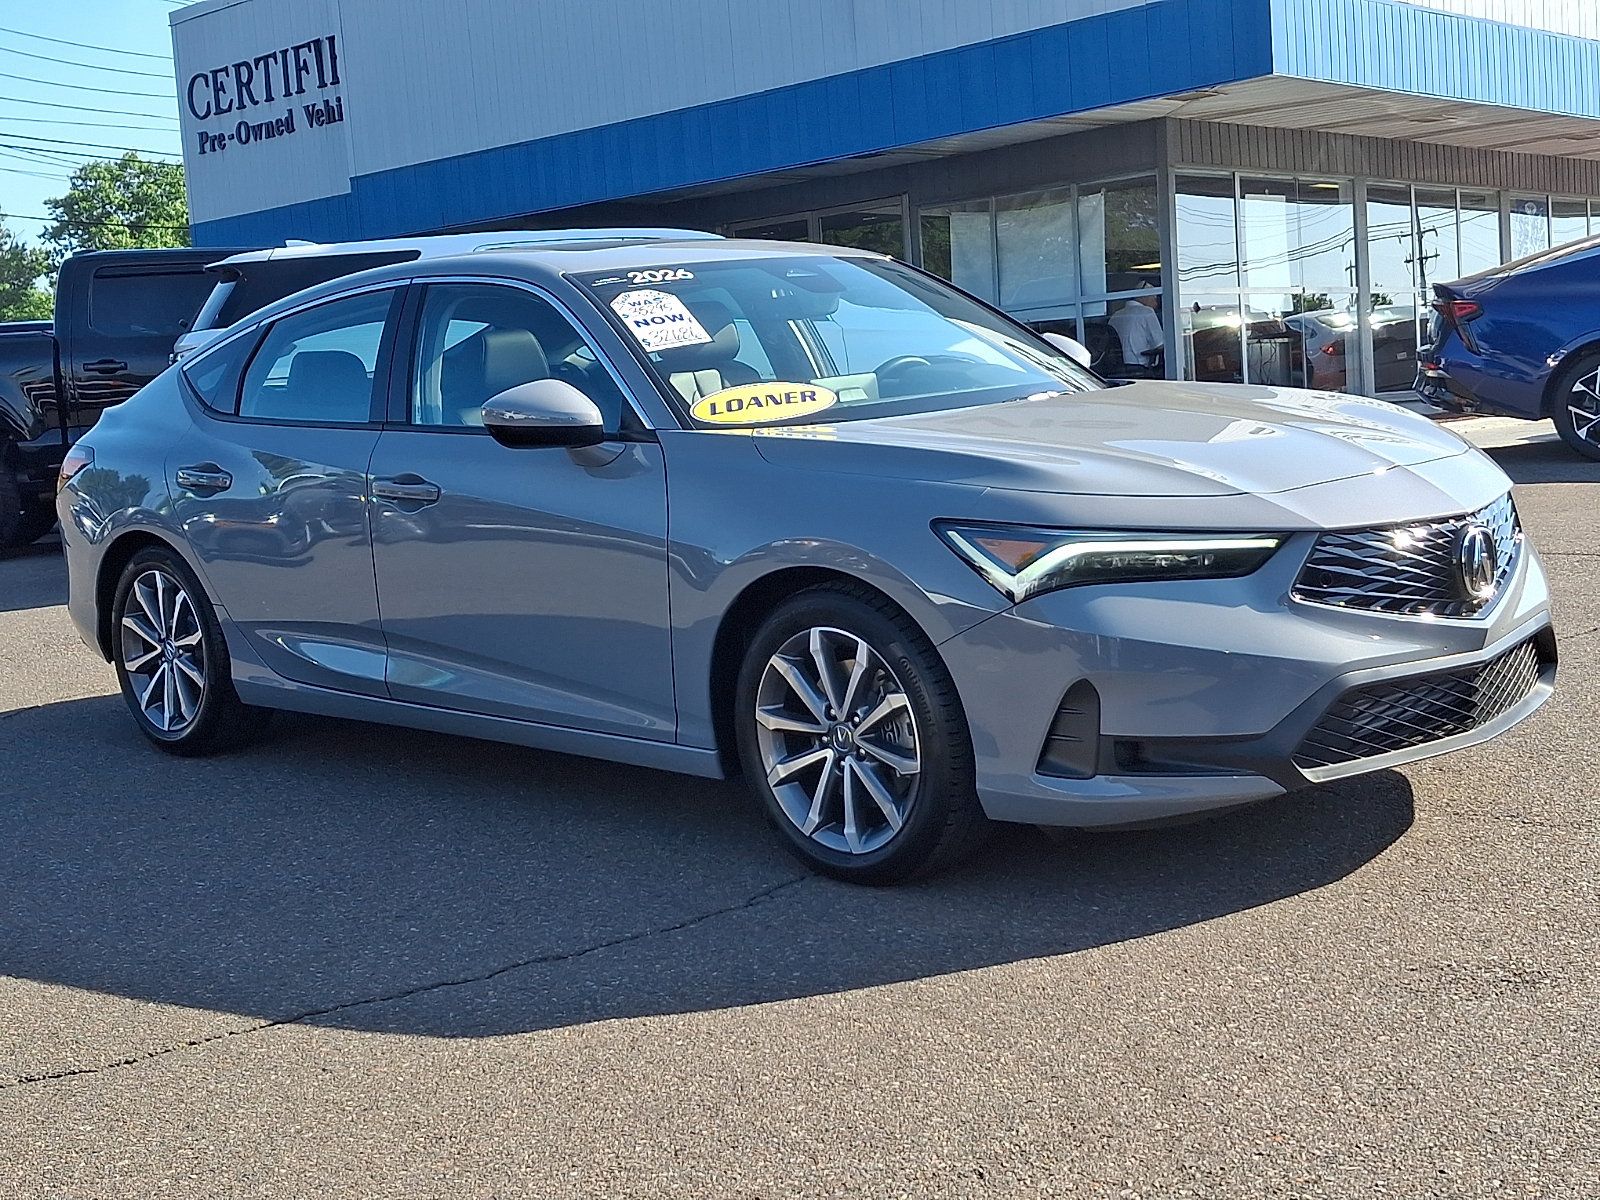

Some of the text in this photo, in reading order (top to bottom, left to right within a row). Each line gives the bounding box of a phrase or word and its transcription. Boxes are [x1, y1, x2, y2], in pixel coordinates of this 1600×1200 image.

[197, 96, 344, 155] Pre-Owned Vehi
[627, 268, 694, 284] 2026
[628, 296, 663, 307] WAS
[633, 313, 685, 328] NOW
[710, 390, 817, 416] LOANER
